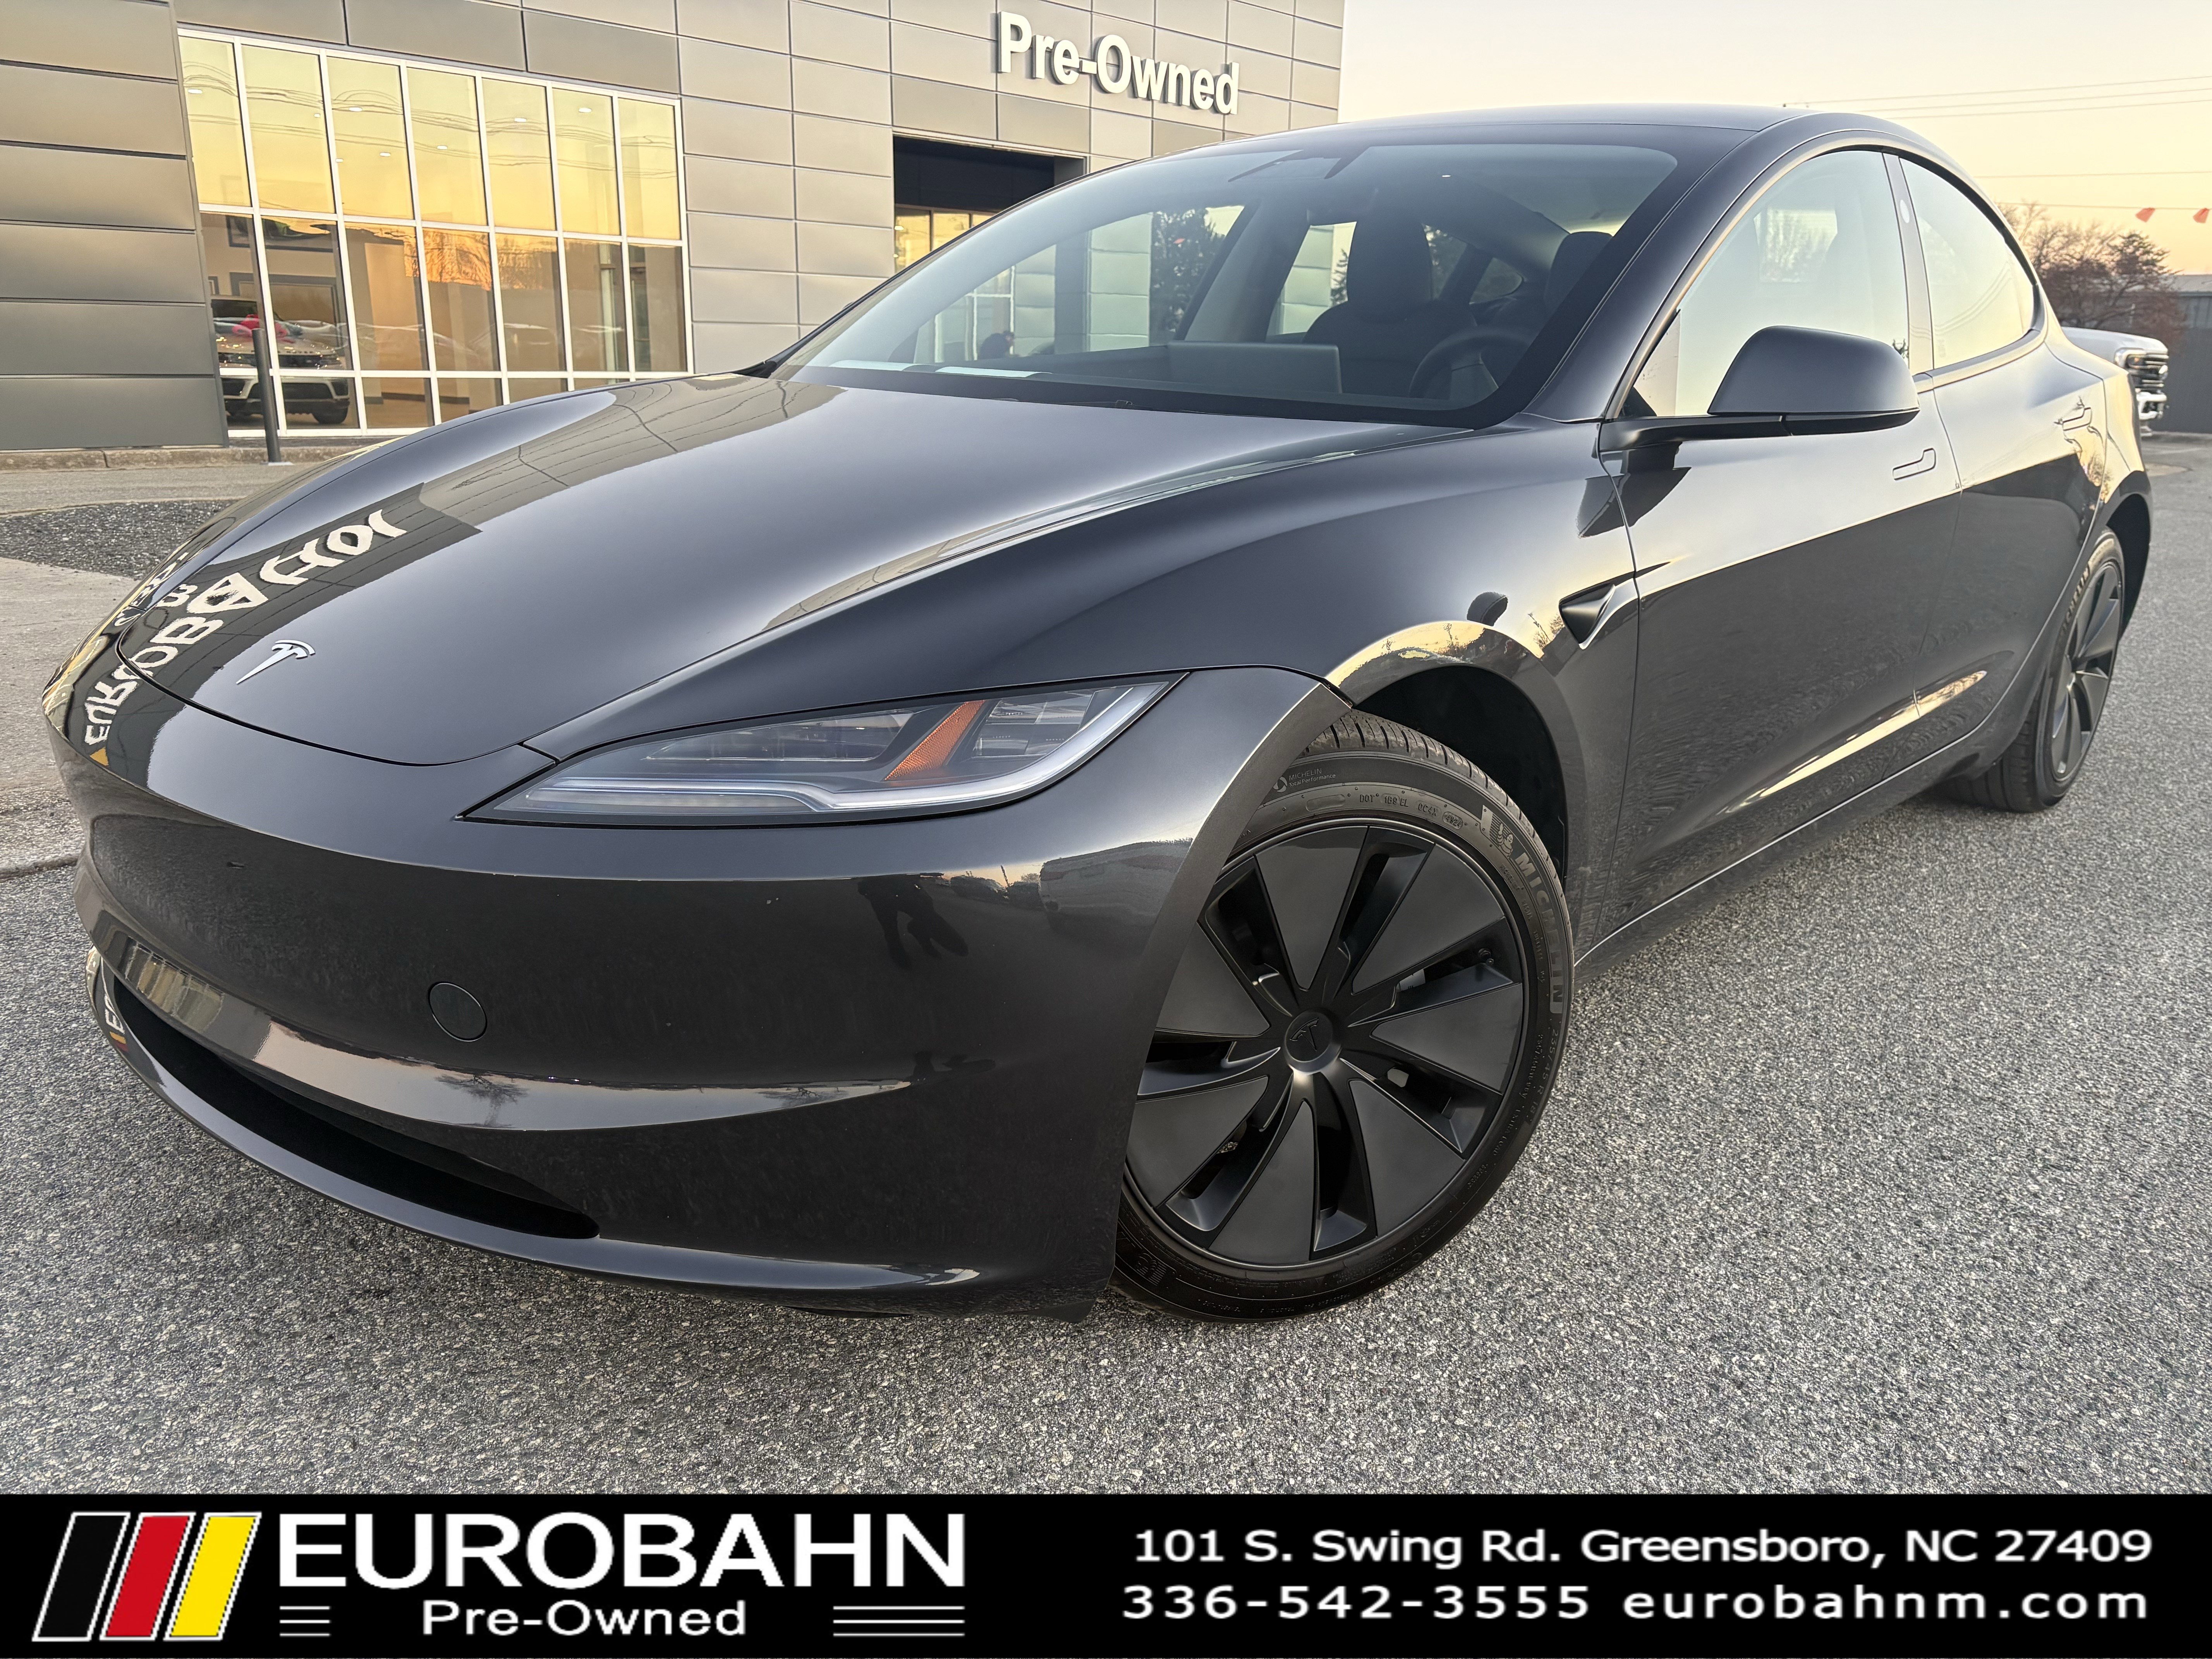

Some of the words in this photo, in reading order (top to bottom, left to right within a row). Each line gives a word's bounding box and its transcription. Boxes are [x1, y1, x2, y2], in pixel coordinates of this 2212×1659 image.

[998, 11, 1239, 115] Pre-Owned
[1288, 768, 1322, 781] MICHELIN
[1302, 774, 1336, 783] Performance
[1360, 794, 1375, 803] DOT
[1515, 852, 1563, 1003] MICHELIN
[1542, 1028, 1559, 1080] 235/45
